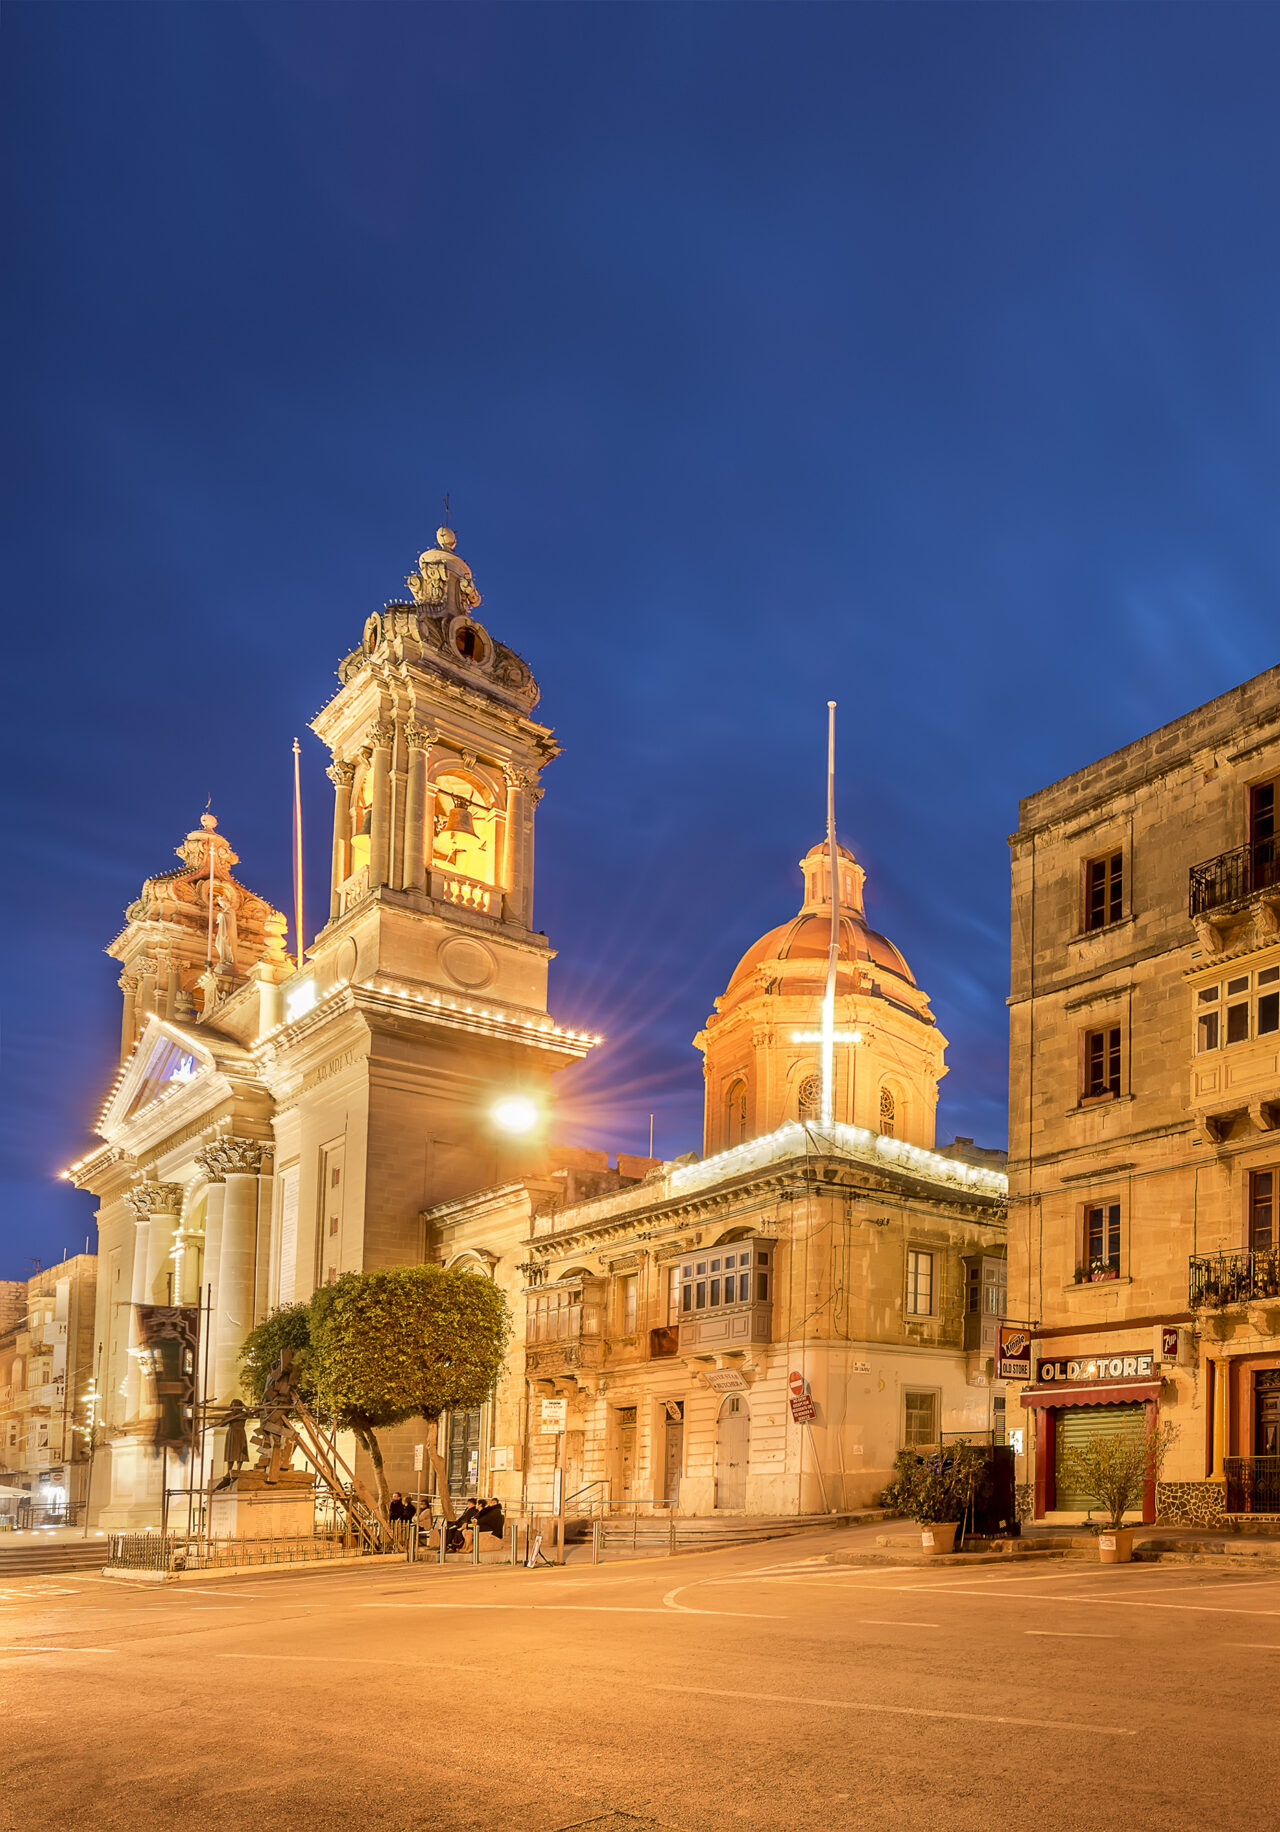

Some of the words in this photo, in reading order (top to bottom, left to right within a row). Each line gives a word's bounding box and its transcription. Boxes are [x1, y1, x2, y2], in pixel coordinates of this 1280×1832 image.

[1004, 1334, 1025, 1355] Kinnie
[1003, 1363, 1012, 1373] OLD
[1012, 1364, 1027, 1374] STORE
[1041, 1362, 1080, 1380] OLD
[1082, 1357, 1152, 1378] STORE
[716, 1381, 739, 1389] BUTCHER
